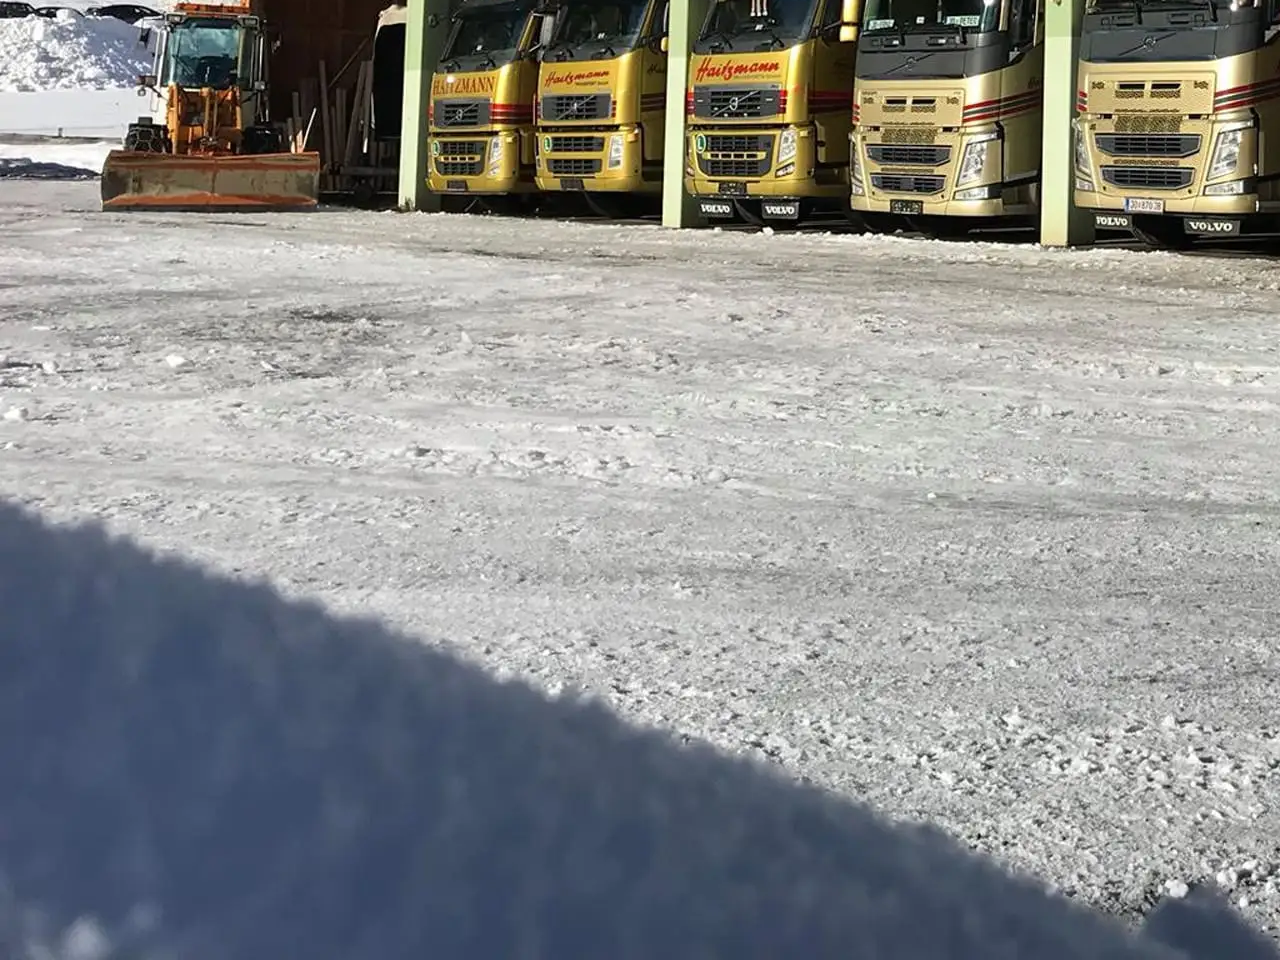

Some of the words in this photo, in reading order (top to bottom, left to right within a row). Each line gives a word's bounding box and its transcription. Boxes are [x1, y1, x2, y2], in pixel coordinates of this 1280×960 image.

[696, 57, 779, 82] Haitzmann
[545, 70, 609, 87] Haitzmann
[701, 204, 730, 213] VOLVO
[765, 206, 794, 215] VOLVO
[1189, 221, 1233, 232] VOLVO
